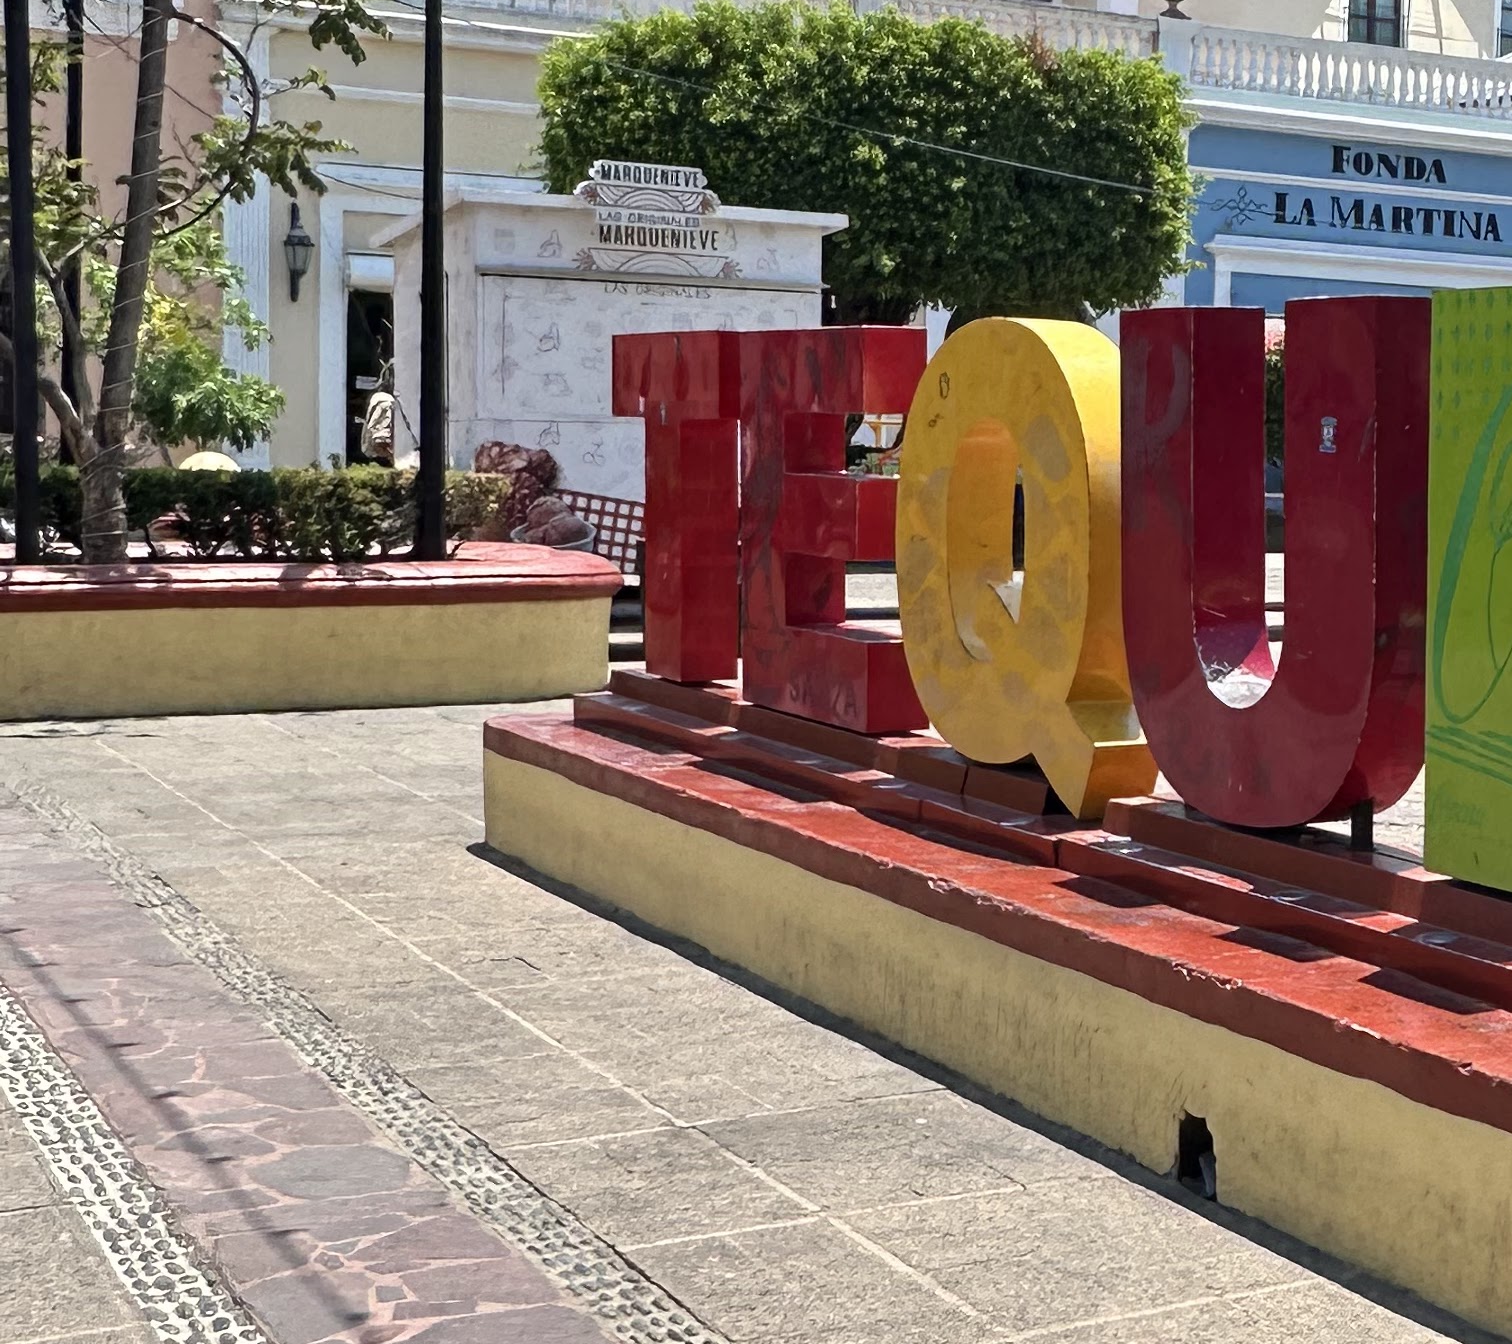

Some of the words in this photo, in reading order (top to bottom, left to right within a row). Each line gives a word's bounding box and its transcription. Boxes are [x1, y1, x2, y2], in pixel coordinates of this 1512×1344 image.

[1332, 145, 1447, 184] FONDA
[1273, 192, 1317, 227] LA
[1330, 195, 1503, 243] MARTINA
[599, 224, 719, 251] MARQUENIEVE
